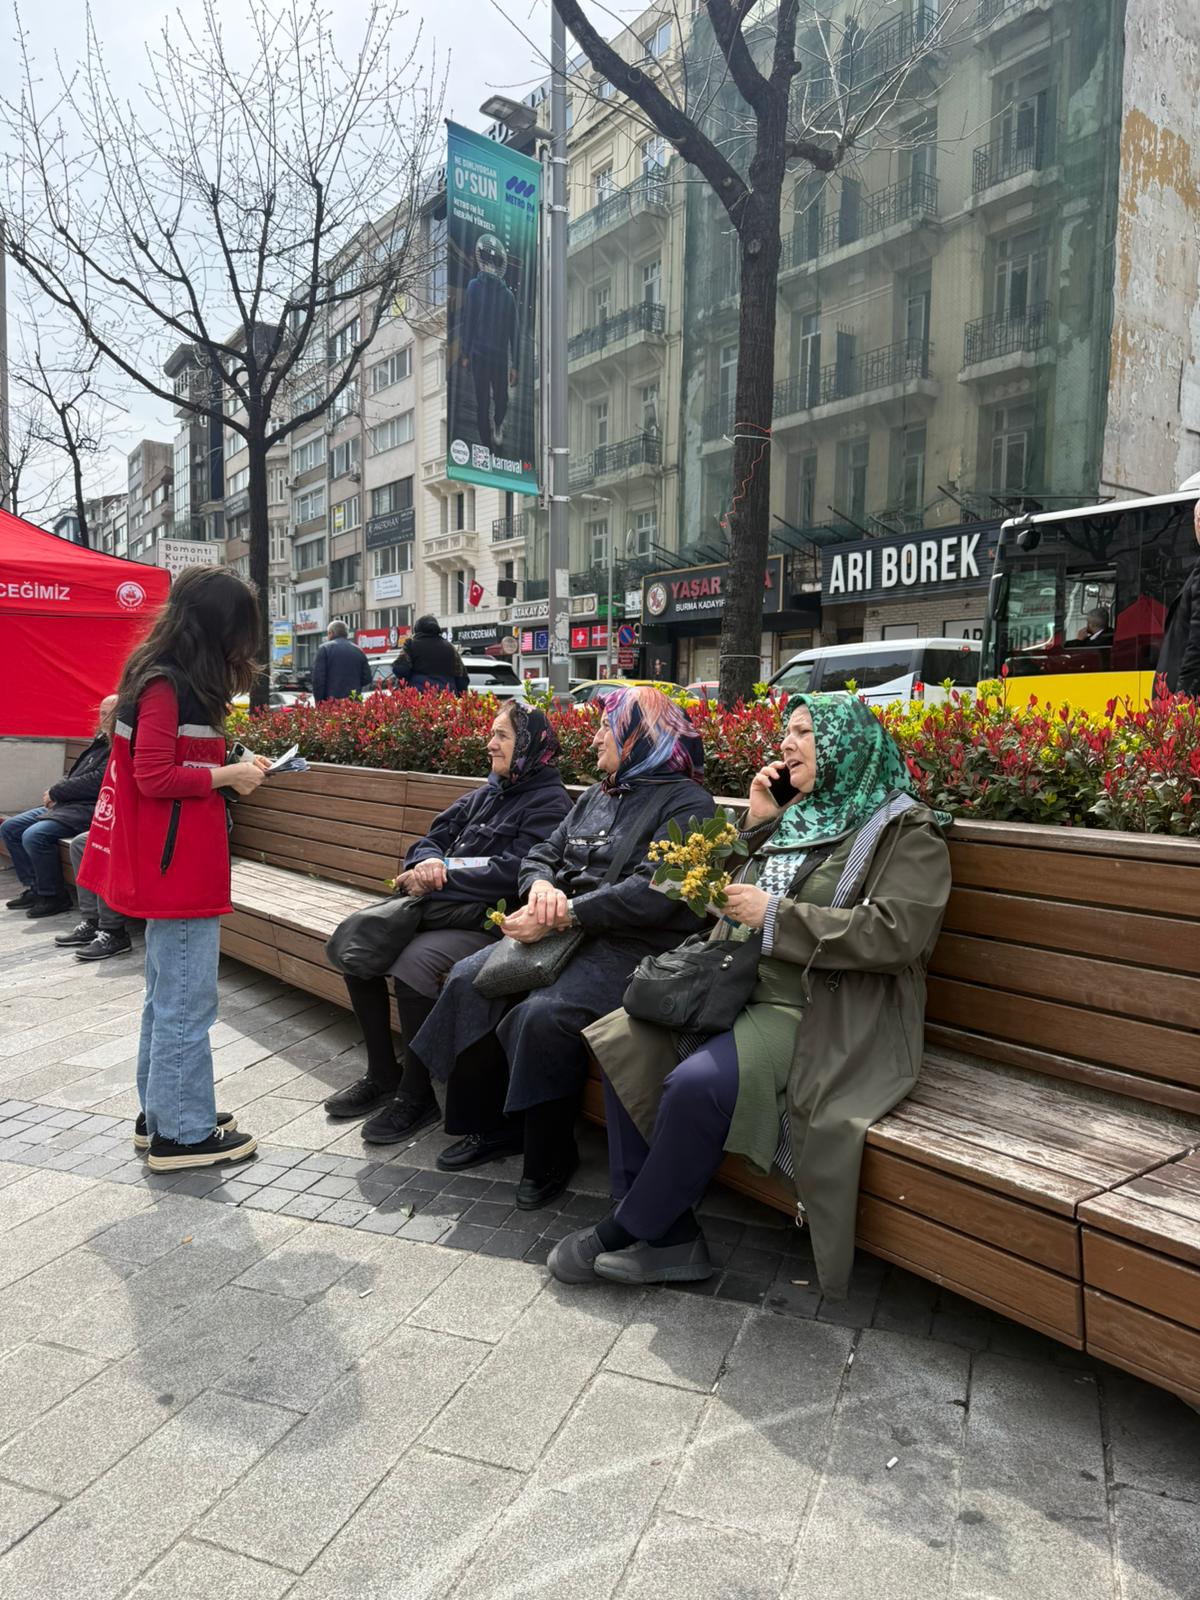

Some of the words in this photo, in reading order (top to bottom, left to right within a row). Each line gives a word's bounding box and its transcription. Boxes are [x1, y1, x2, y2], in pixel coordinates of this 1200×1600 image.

[454, 167, 498, 201] O'SUN
[492, 453, 522, 474] karnaval
[165, 544, 212, 555] Bomonti
[829, 549, 873, 594] ARI
[675, 602, 697, 612] BURMA
